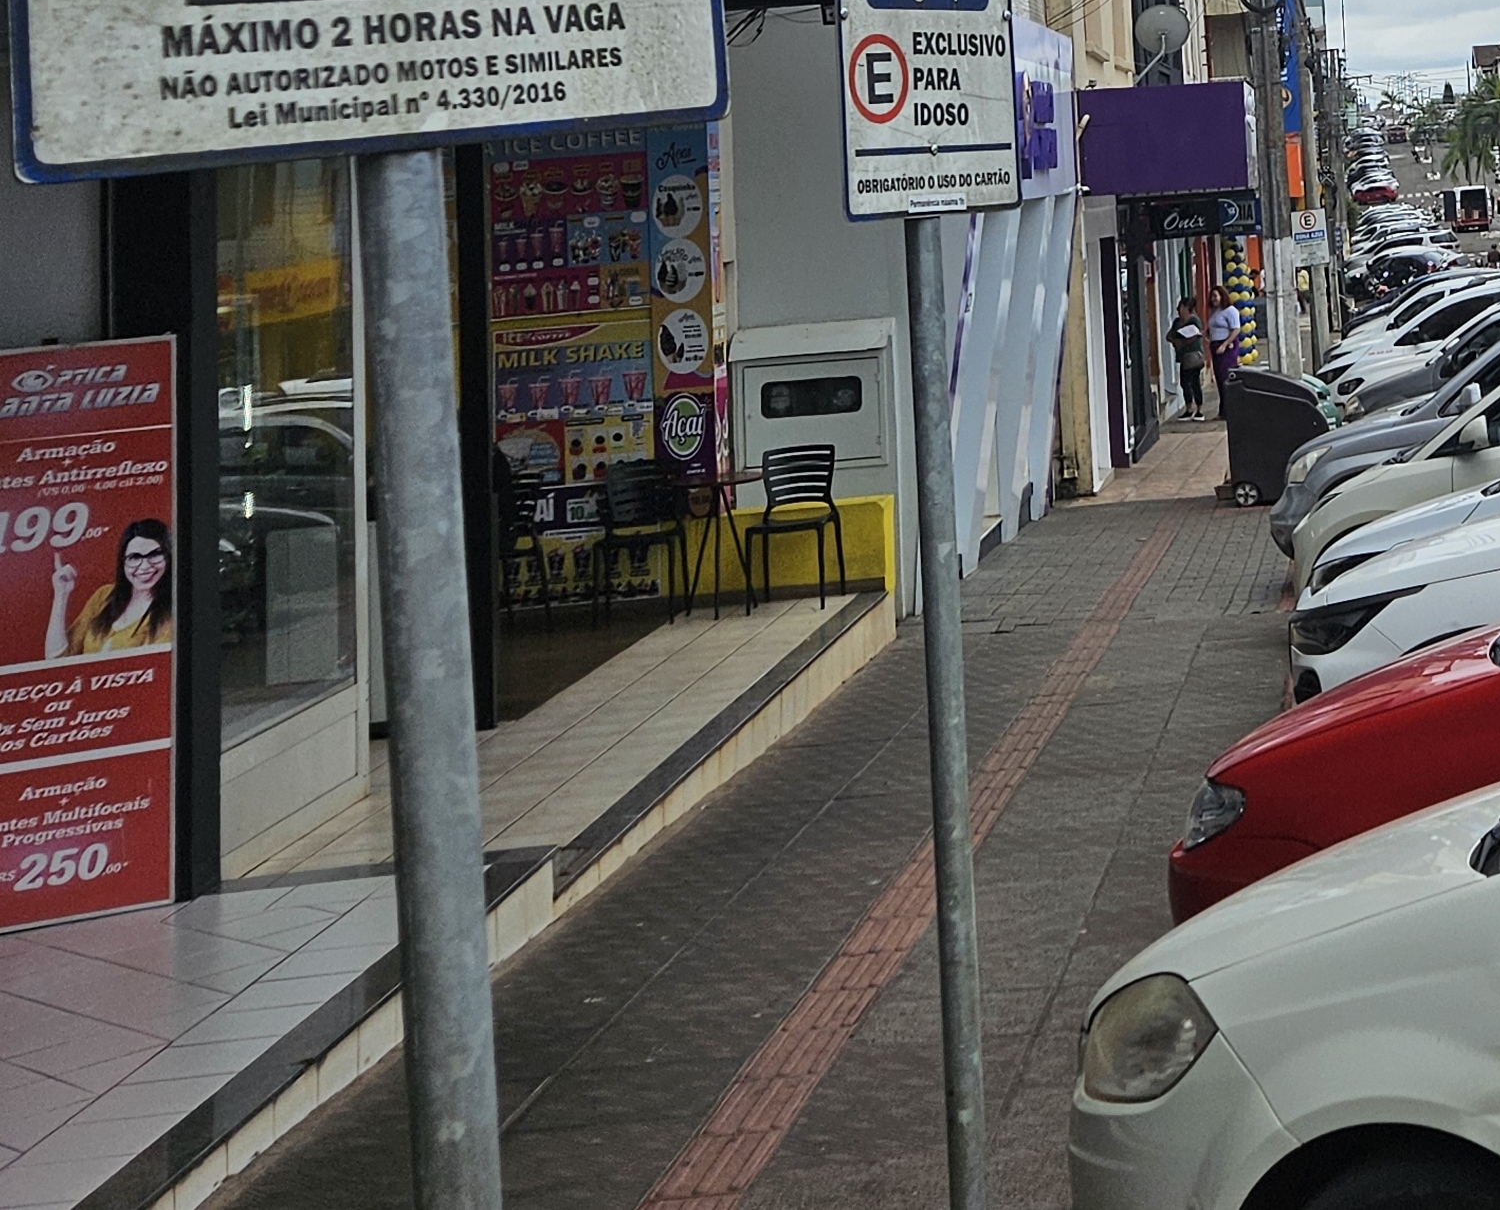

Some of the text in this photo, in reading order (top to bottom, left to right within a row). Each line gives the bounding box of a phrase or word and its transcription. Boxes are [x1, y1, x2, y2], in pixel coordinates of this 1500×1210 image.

[161, 3, 625, 59] MÁXIMO 2 HORAS NA VAGA
[913, 31, 1006, 57] EXCLUSIVO
[159, 48, 622, 101] NÃO AUTORIZADO MOTOS E SIMILARES
[866, 52, 894, 104] E
[913, 67, 961, 91] PARA
[228, 105, 268, 130] Lei
[275, 97, 399, 127] Municipal
[437, 81, 566, 112] 4.330/2016
[914, 102, 969, 127] IDOSO
[504, 137, 542, 154] ICE
[550, 129, 642, 150] COFFEE
[857, 168, 1010, 195] OBRIGATÓRIO O USO DO CARTÃO
[1163, 208, 1206, 231] Ônix
[1304, 215, 1312, 226] E
[499, 342, 645, 369] MILK SHAKE
[79, 383, 161, 409] LUZIA
[663, 404, 705, 445] Açaí
[16, 439, 116, 463] Armação
[39, 460, 168, 485] Antirreflexo
[0, 682, 62, 704] REÇO
[90, 668, 153, 691] VISTA
[18, 716, 65, 734] Sem
[69, 705, 130, 727] Juros
[44, 700, 72, 713] ou
[30, 723, 113, 748] Cartões
[19, 776, 107, 802] Armação
[42, 796, 151, 826] Multifocais
[2, 816, 124, 848] Progressivas
